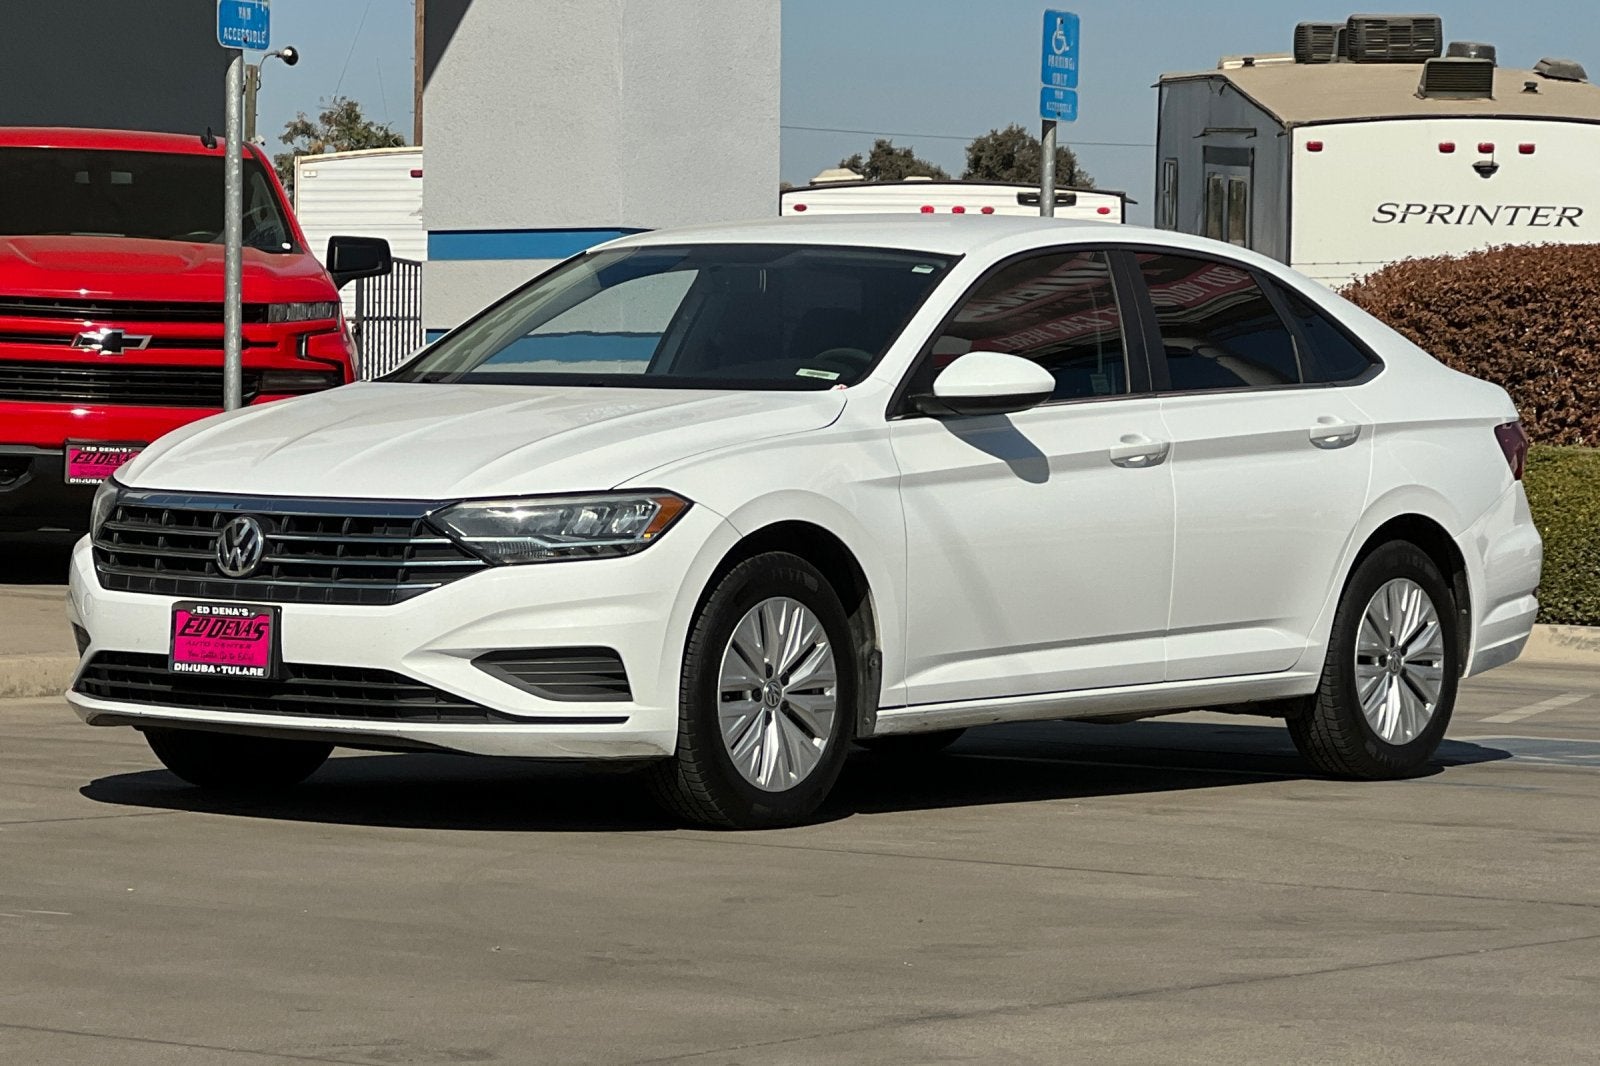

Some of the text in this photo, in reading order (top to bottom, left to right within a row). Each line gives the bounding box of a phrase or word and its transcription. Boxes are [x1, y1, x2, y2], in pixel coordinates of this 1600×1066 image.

[223, 27, 267, 44] ACCESSIBLE
[1371, 202, 1585, 227] SPRINTER
[71, 452, 98, 464] ED
[196, 605, 249, 616] ED DENA'S
[177, 617, 211, 637] ED
[214, 641, 252, 650] CENTER
[221, 665, 264, 677] TULARE
